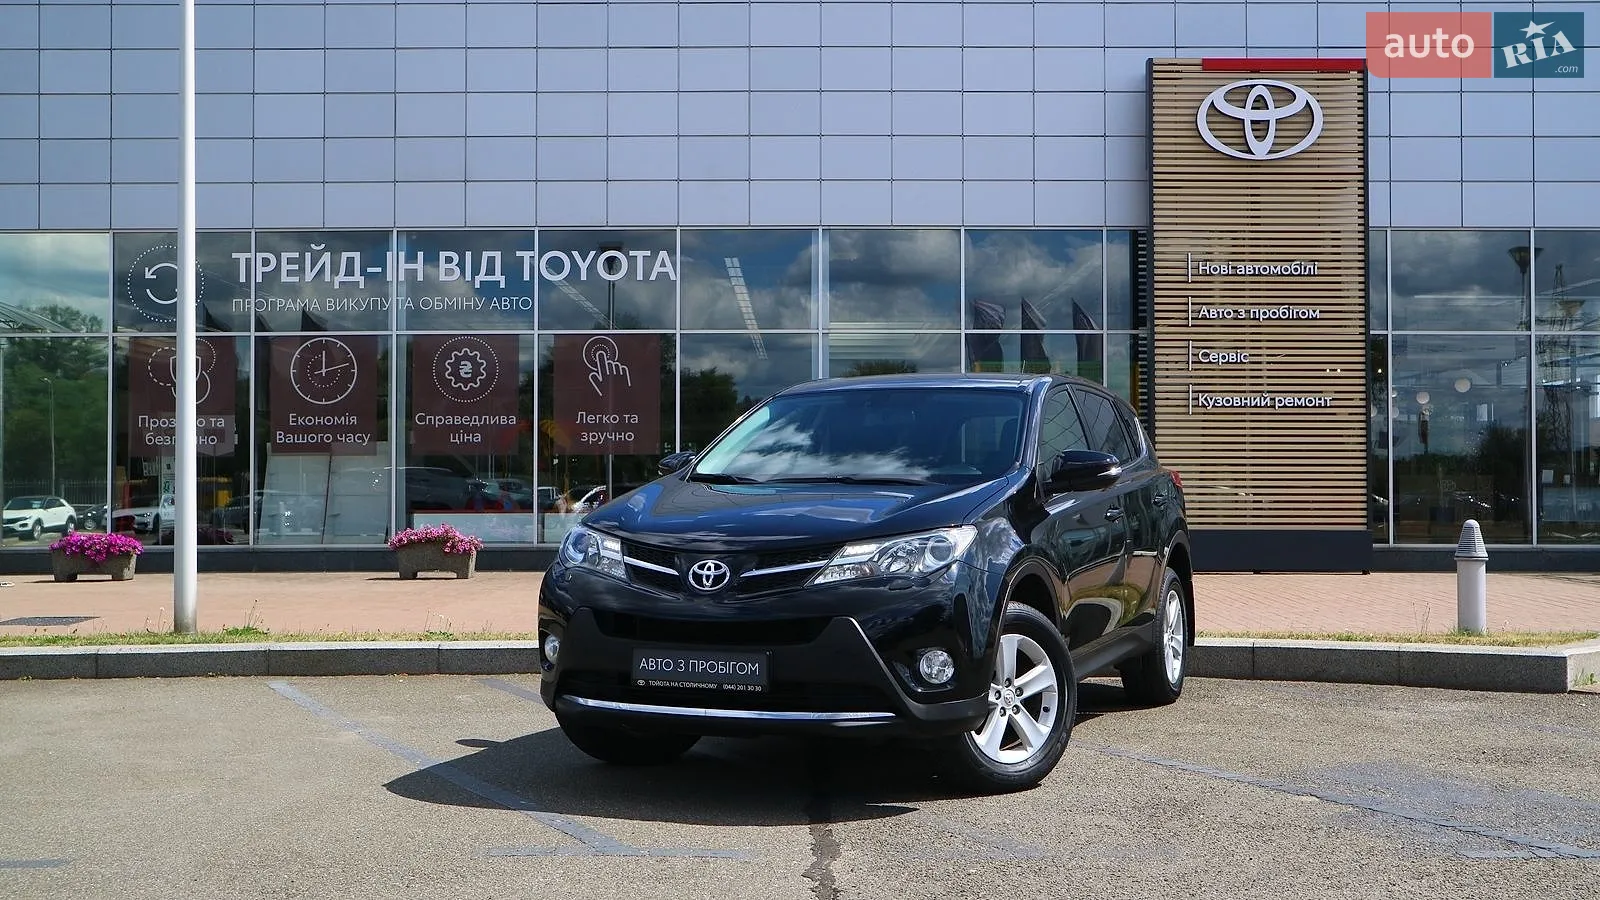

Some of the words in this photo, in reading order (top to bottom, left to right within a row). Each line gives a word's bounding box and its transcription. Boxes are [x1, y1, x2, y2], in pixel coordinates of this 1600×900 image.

[231, 243, 424, 289] ТРЕЙД-ІН
[439, 250, 506, 289] ВІД
[515, 249, 677, 282] TOYOTA
[1198, 261, 1232, 275] Нові
[1236, 261, 1318, 275] автомобілі
[232, 297, 323, 312] ПРОГРАМА
[326, 297, 392, 311] ВИКУПУ
[396, 296, 415, 310] ТА
[419, 296, 485, 311] ОБМІНУ
[489, 296, 533, 311] АВТО
[1198, 305, 1234, 319] Авто
[1237, 309, 1246, 319] з
[1250, 305, 1320, 322] пробігом
[1198, 350, 1250, 365] Сервіс
[1198, 392, 1271, 410] Кузовний
[1275, 396, 1333, 410] ремонт
[138, 415, 206, 431] Прозо
[209, 418, 225, 428] та
[289, 412, 358, 426] Економія
[415, 412, 517, 427] Справедлива
[576, 411, 620, 425] Легко
[623, 415, 639, 425] та
[145, 432, 218, 445] безно
[276, 431, 333, 444] Вашого
[337, 434, 371, 446] часу
[450, 432, 482, 444] ціна
[580, 431, 635, 443] зручно
[639, 658, 674, 671] АВТО
[677, 660, 685, 672] З
[689, 660, 760, 675] ПРОБІГОМ
[648, 680, 670, 688] ТОЙОТА
